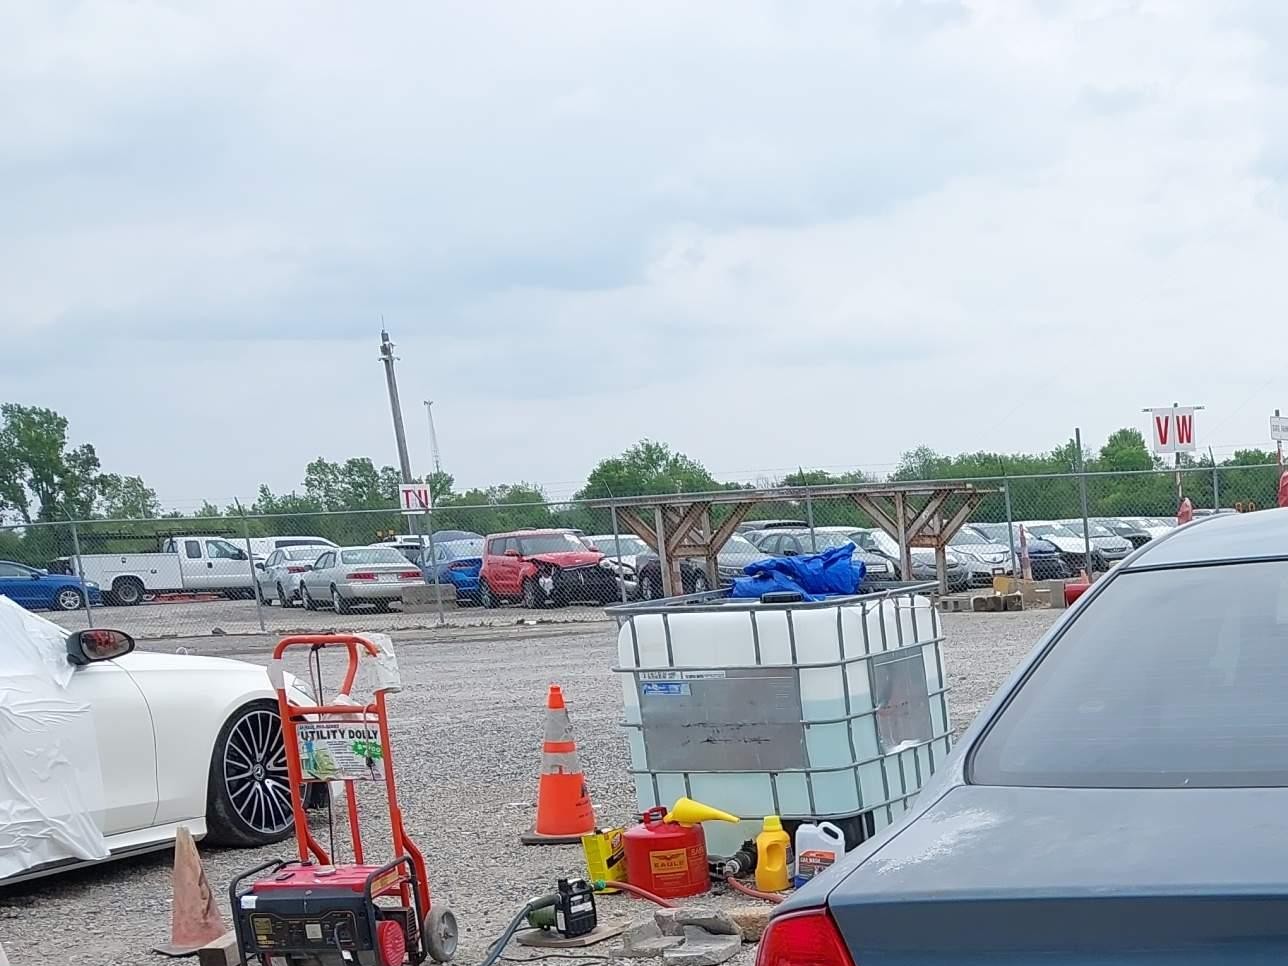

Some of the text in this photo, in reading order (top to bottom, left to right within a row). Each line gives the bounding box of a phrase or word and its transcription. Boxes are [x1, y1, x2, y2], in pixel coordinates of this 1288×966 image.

[1155, 414, 1192, 445] V W
[402, 489, 411, 508] T
[301, 729, 378, 740] UTILITY DOLLY
